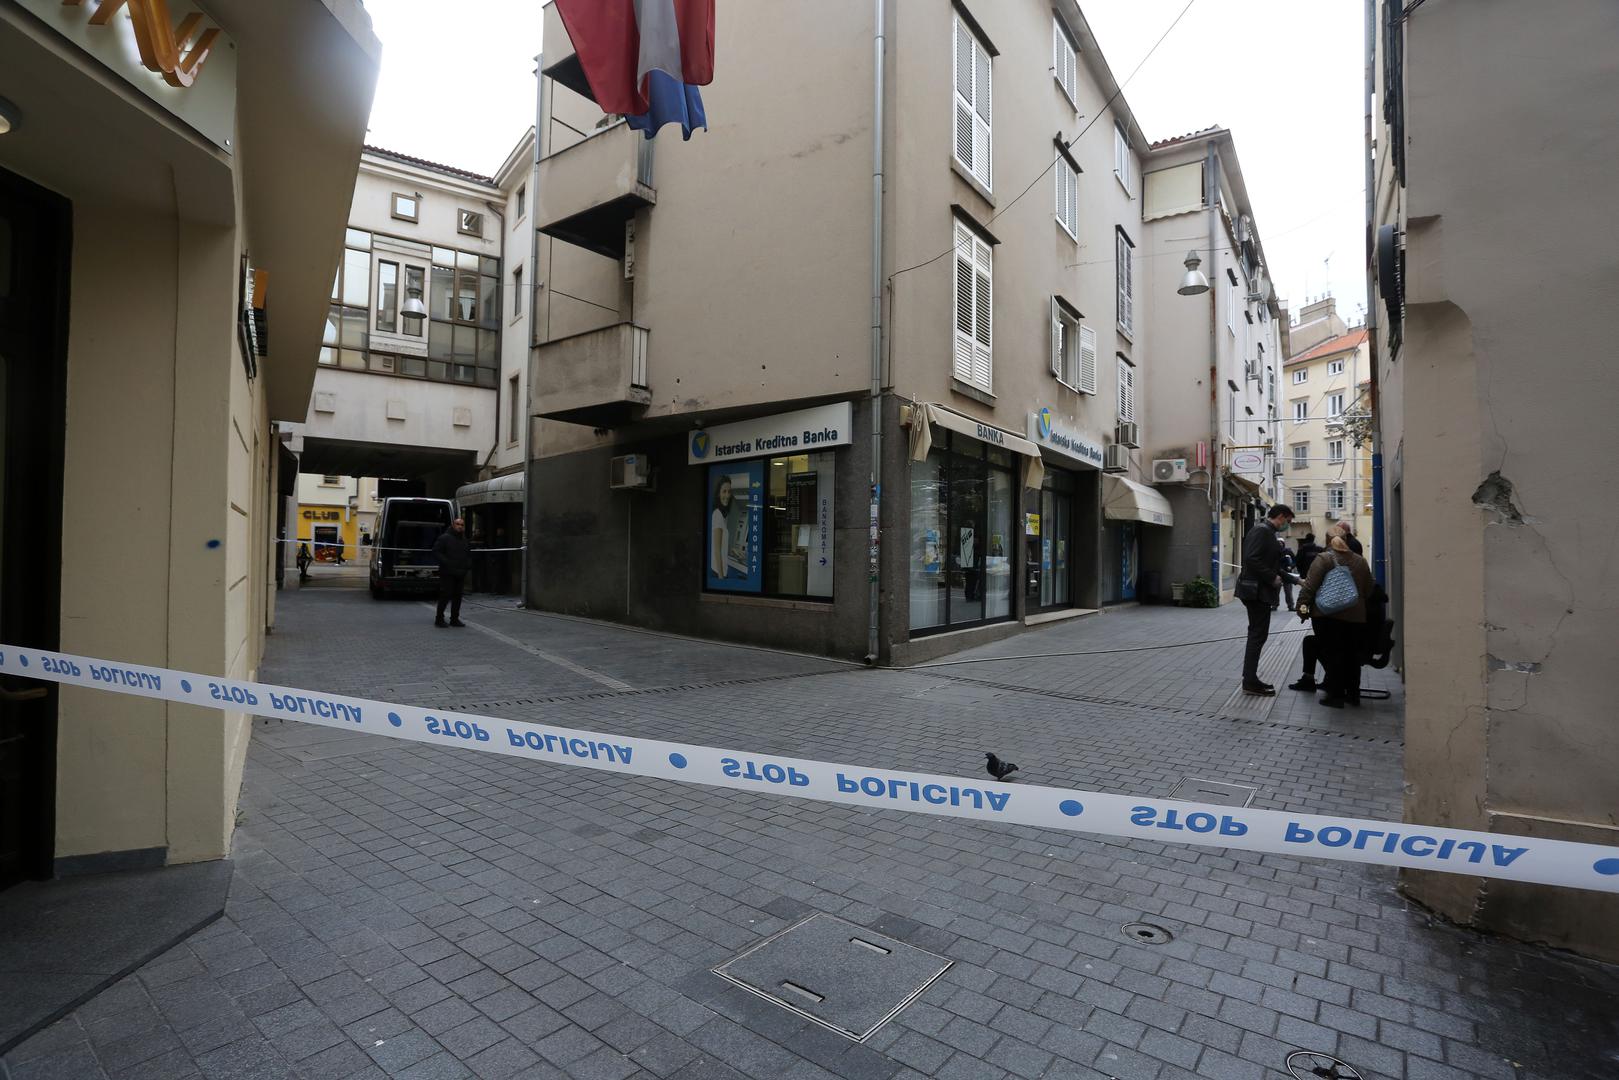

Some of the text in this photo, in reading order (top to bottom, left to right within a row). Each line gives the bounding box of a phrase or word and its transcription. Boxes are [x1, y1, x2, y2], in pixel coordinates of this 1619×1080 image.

[715, 428, 838, 457] Istarska Kreditna Banka
[977, 423, 1004, 445] BANKA
[303, 510, 340, 521] CLUB
[820, 499, 828, 554] BANKOMAT
